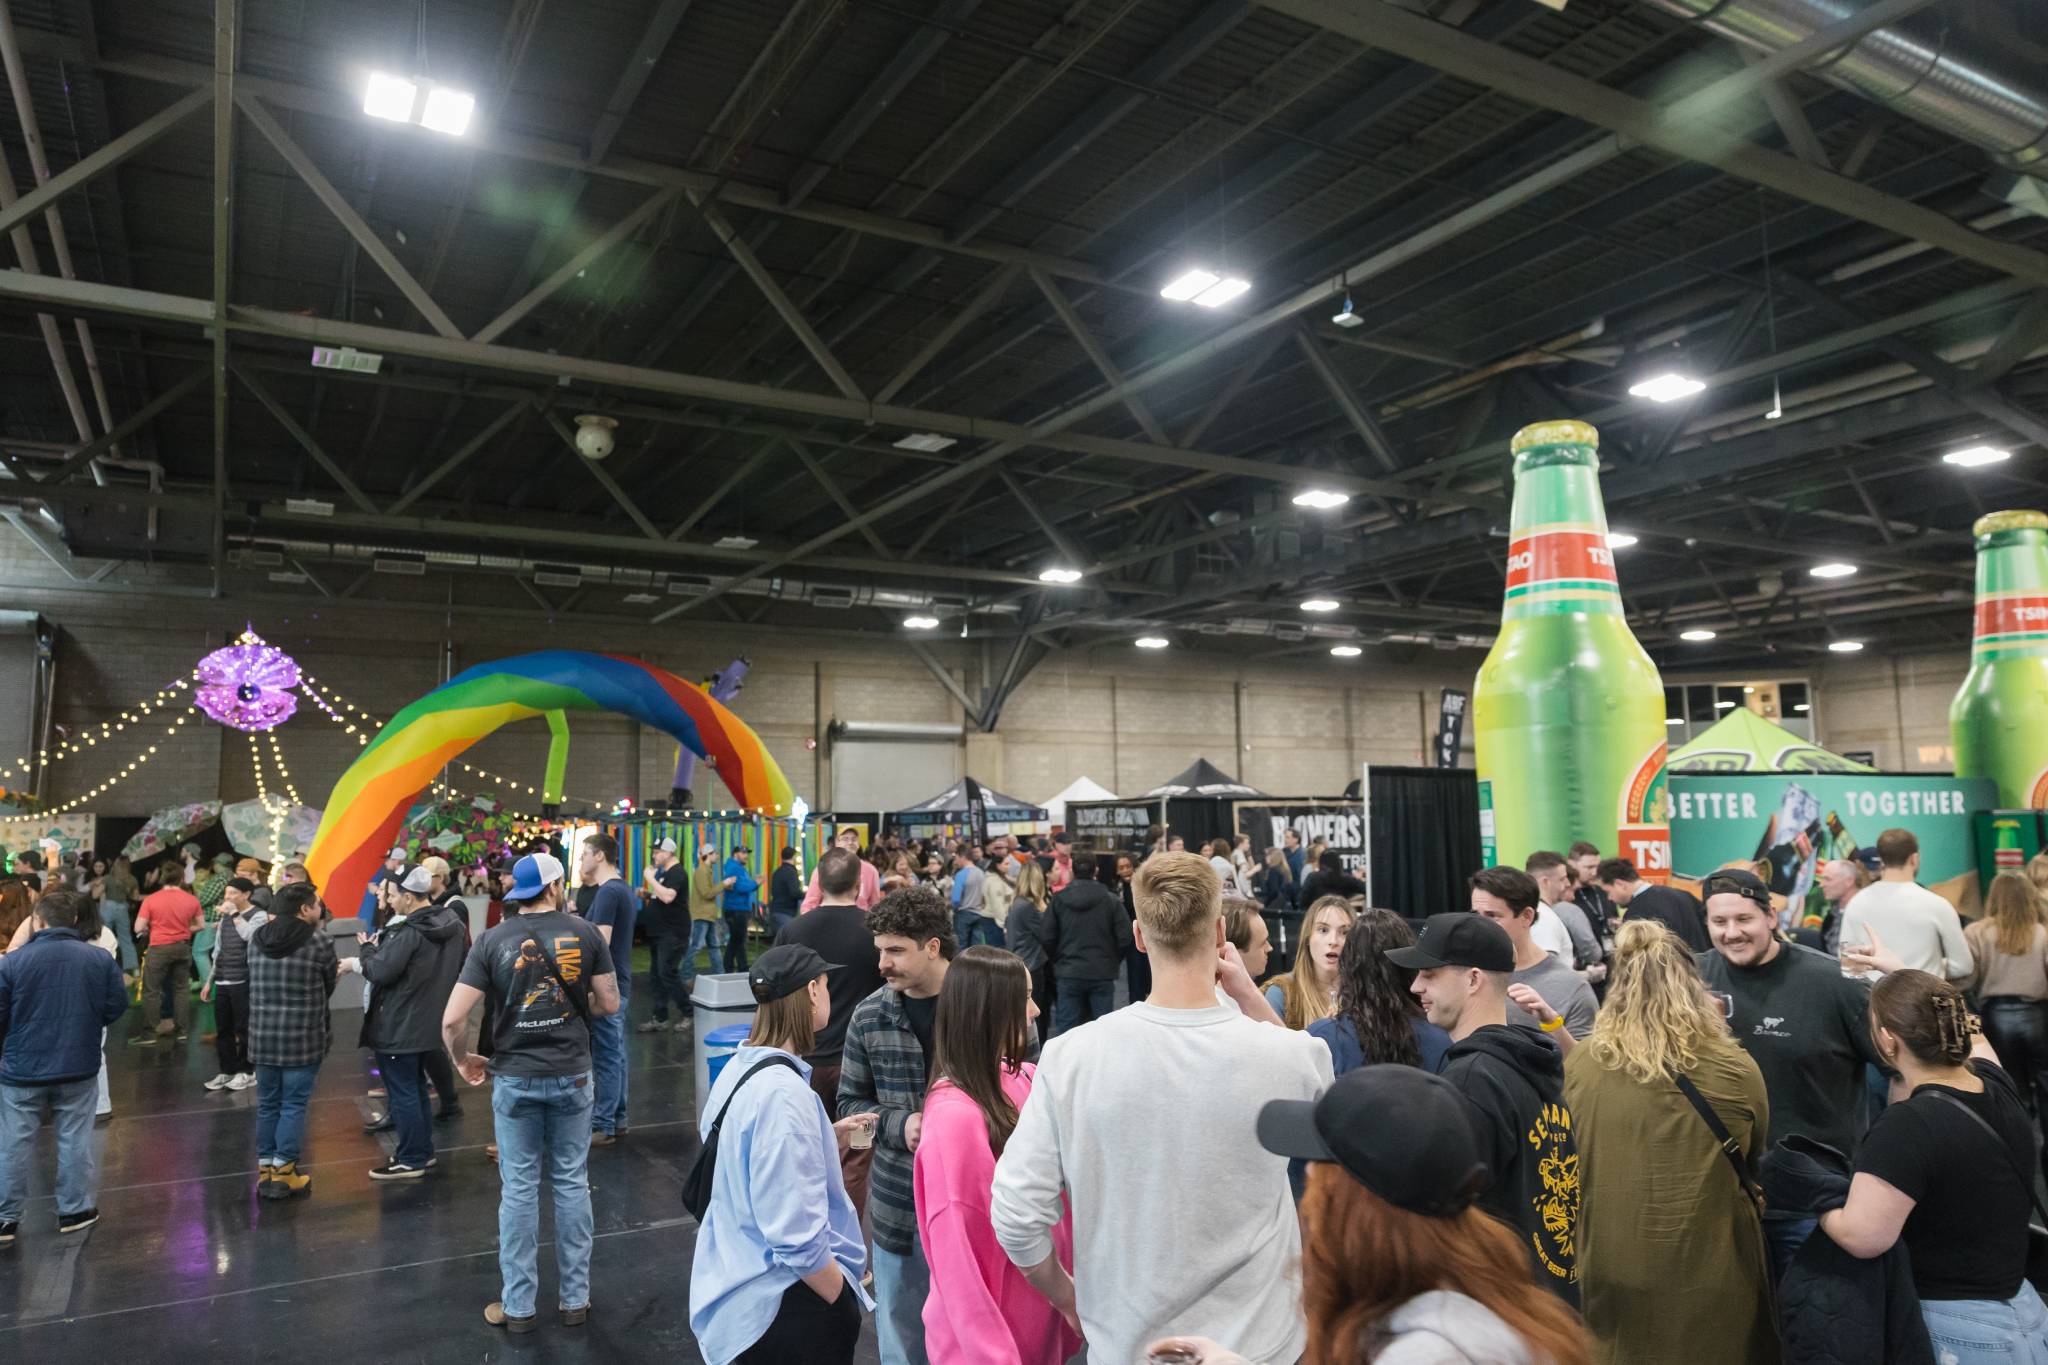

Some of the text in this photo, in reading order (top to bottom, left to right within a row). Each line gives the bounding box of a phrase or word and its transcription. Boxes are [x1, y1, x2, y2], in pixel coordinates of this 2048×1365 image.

[1668, 790, 1965, 820] BETTER TOGETHER
[554, 937, 582, 983] LN4
[515, 1018, 565, 1028] McLaren
[1533, 1232, 1567, 1278] GREAT BEER
